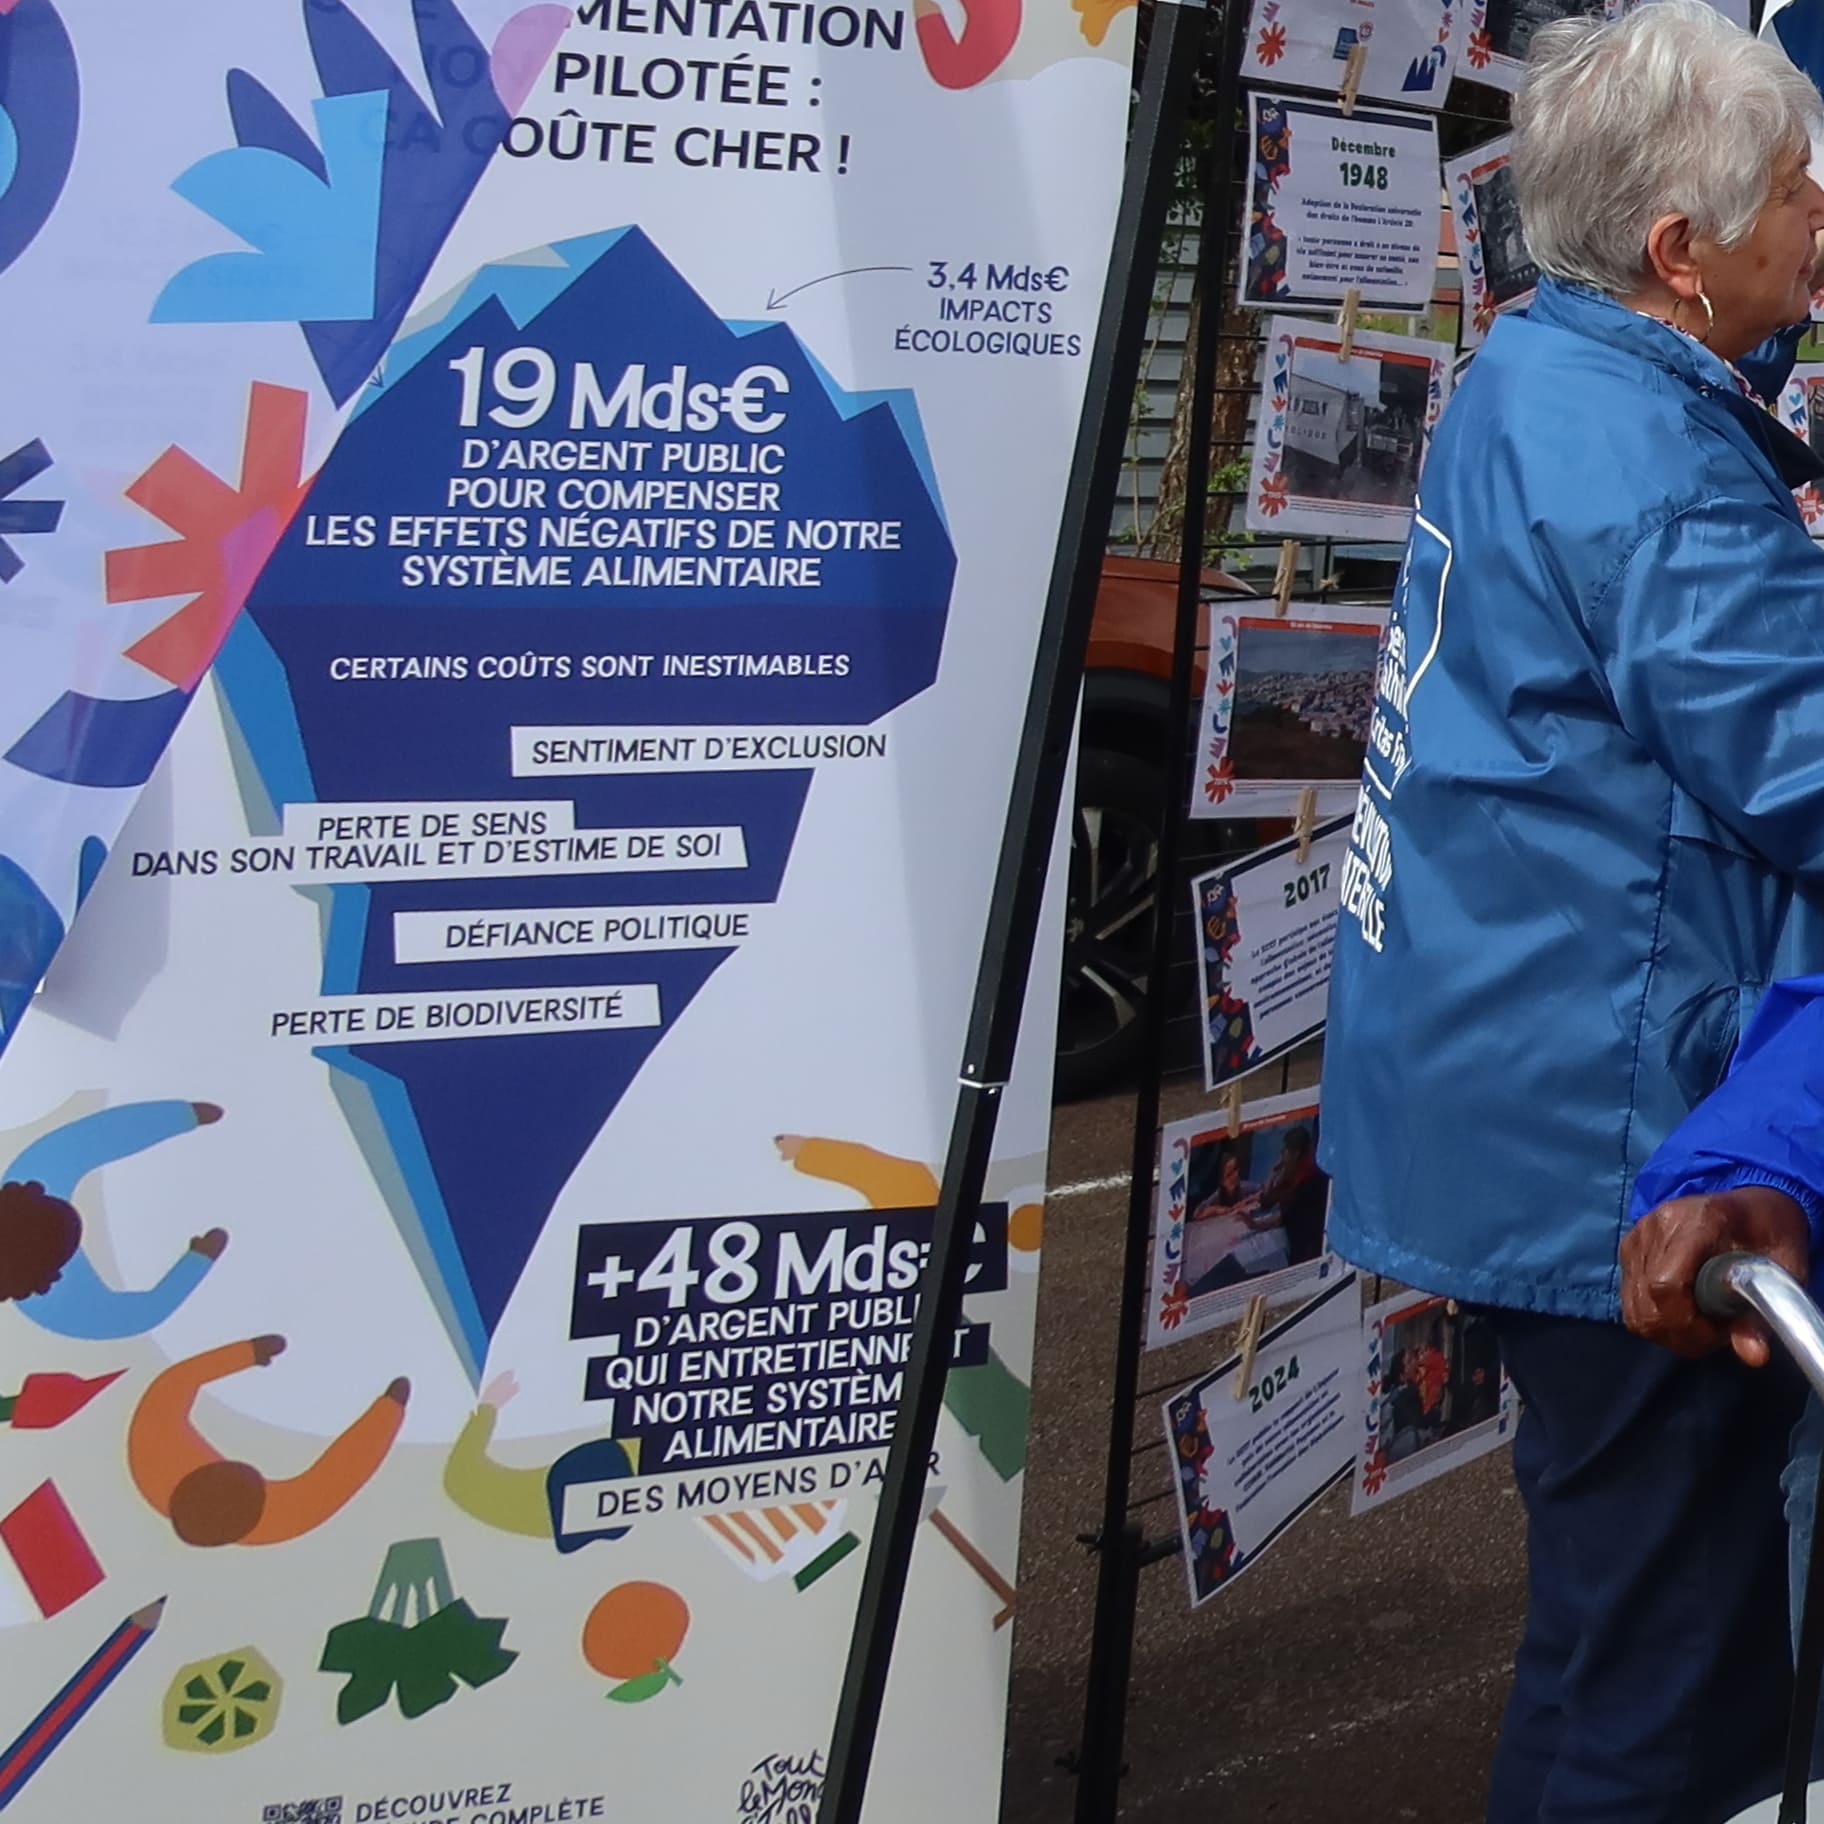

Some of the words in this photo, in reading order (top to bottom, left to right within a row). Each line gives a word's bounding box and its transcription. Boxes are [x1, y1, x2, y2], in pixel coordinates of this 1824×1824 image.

[552, 50, 791, 108] PILOTÉE
[674, 125, 823, 175] CHER
[836, 133, 852, 176] !
[1330, 136, 1397, 159] Décembre
[1339, 161, 1389, 191] 1948
[927, 261, 978, 292] 3,4
[985, 262, 1070, 293] Mds€
[939, 297, 1053, 325] IMPACTS
[894, 324, 1082, 357] ÉCOLOGIQUES
[449, 346, 558, 429] 19
[568, 362, 791, 434] Mds€
[461, 438, 653, 473] D'ARGENT
[661, 442, 786, 476] PUBLIC
[447, 477, 547, 509] POUR
[557, 478, 782, 512] COMPENSER
[305, 515, 377, 547] LES
[388, 515, 528, 549] EFFETS
[538, 511, 717, 550] NÉGATIFS
[726, 519, 776, 550] DE
[785, 519, 902, 550] NOTRE
[401, 548, 573, 588] SYSTÈME
[581, 555, 822, 588] ALIMENTAIRE
[329, 655, 469, 681] CERTAINS
[477, 650, 572, 680] COÛTS
[580, 654, 655, 679] SONT
[662, 654, 851, 678] INESTIMABLES
[532, 737, 697, 765] SENTIMENT
[703, 733, 888, 761] D'EXCLUSION
[318, 815, 411, 842] PERTE
[421, 813, 460, 838] DE
[471, 811, 548, 837] SENS
[131, 849, 219, 877] DANS
[229, 846, 295, 874] SON
[305, 843, 426, 870] TRAVAIL
[437, 841, 476, 866] ET
[483, 836, 618, 864] D'ESTIME
[626, 835, 666, 859] DE
[675, 832, 722, 858] SOI
[1283, 862, 1331, 908] 2017
[445, 919, 595, 949] DÉFIANCE
[603, 914, 750, 943] POLITIQUE
[270, 1008, 366, 1038] PERTE
[375, 1005, 416, 1032] DE
[425, 990, 624, 1029] BIODIVERSITÉ
[587, 1220, 762, 1309] +48
[634, 1302, 820, 1350] D'ARGENT
[827, 1293, 921, 1333] PUBLI
[605, 1353, 670, 1391] QUI
[1247, 1354, 1301, 1414] 2024
[632, 1384, 756, 1427] NOTRE
[766, 1368, 904, 1415] SYSTÈM
[662, 1409, 900, 1464] ALIMENTAIRE
[596, 1484, 665, 1519] DES
[676, 1465, 818, 1510] MOYENS
[751, 1748, 826, 1781] Tout
[355, 1782, 513, 1823] DÉCOUVREZ
